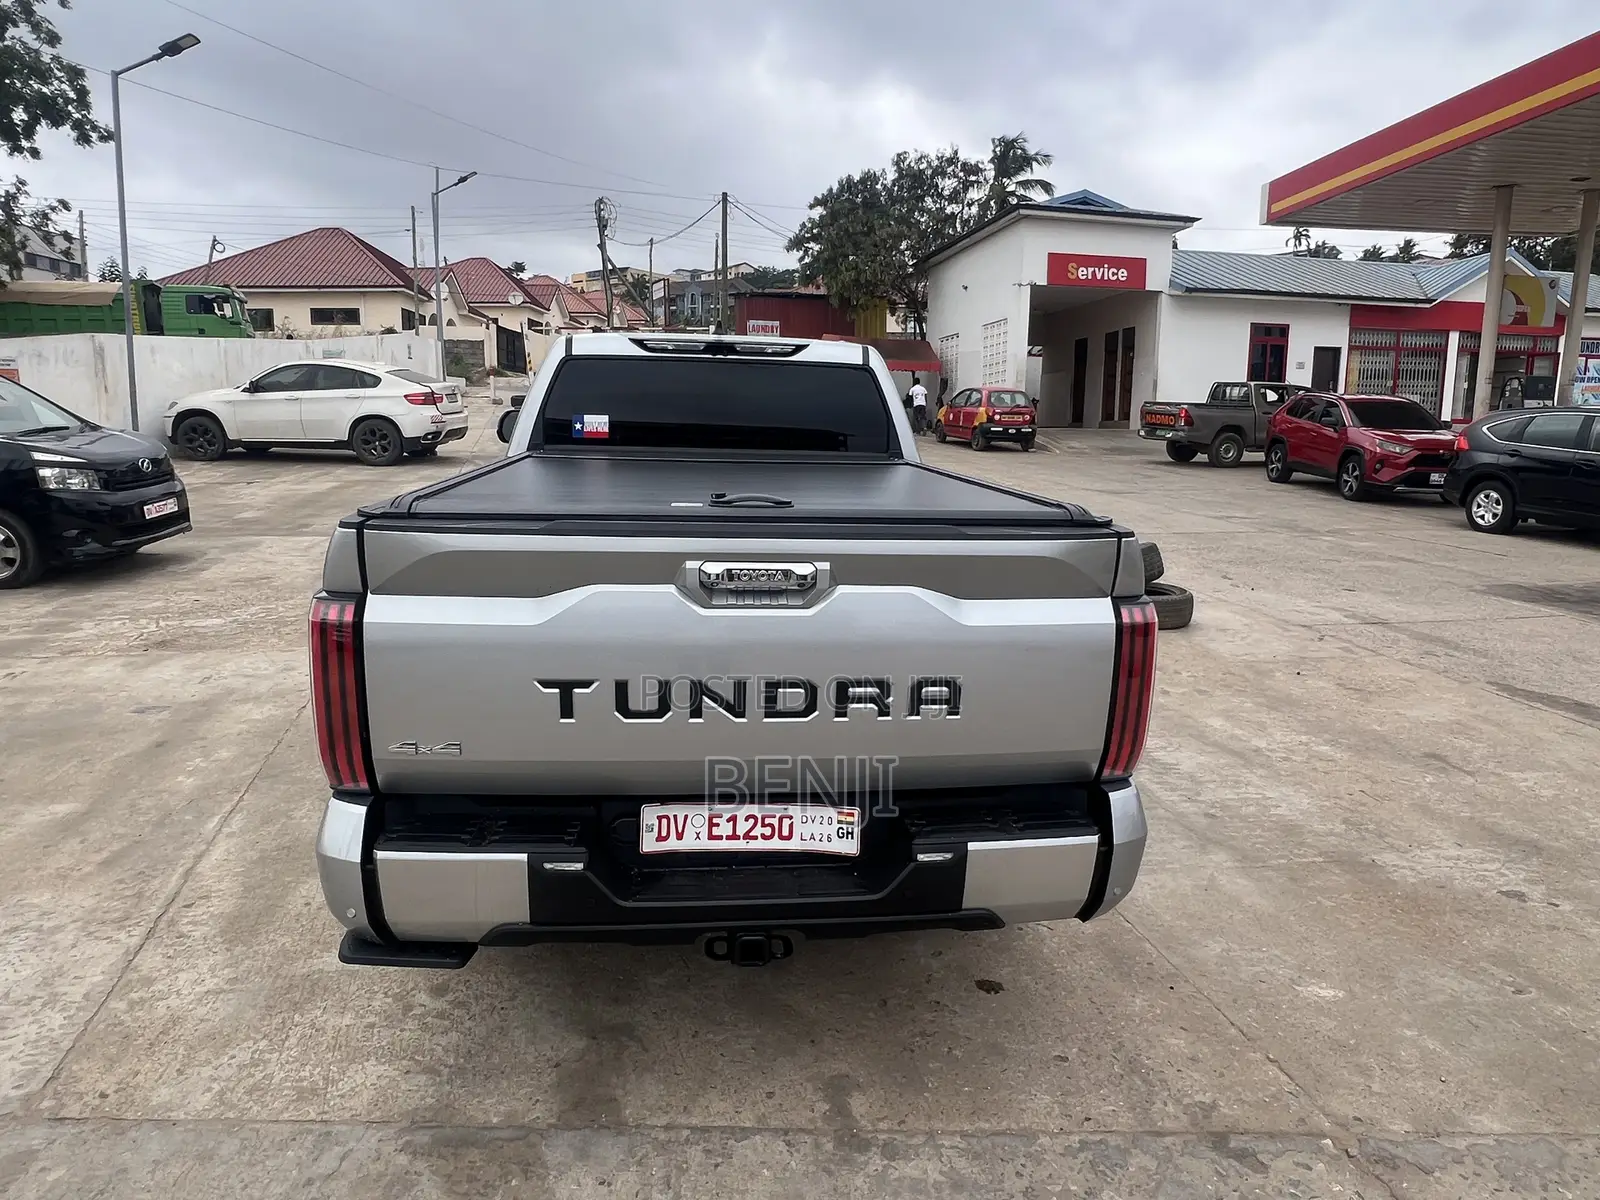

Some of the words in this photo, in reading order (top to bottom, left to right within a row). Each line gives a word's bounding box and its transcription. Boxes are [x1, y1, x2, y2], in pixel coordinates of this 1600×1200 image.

[1067, 262, 1128, 281] Service
[1580, 341, 1600, 354] UNDR
[1146, 413, 1175, 425] NADMO
[731, 569, 786, 582] TOYOTA
[533, 677, 963, 723] TUNDRA
[655, 813, 689, 843] DV
[706, 813, 794, 841] E1250
[836, 826, 855, 841] GH
